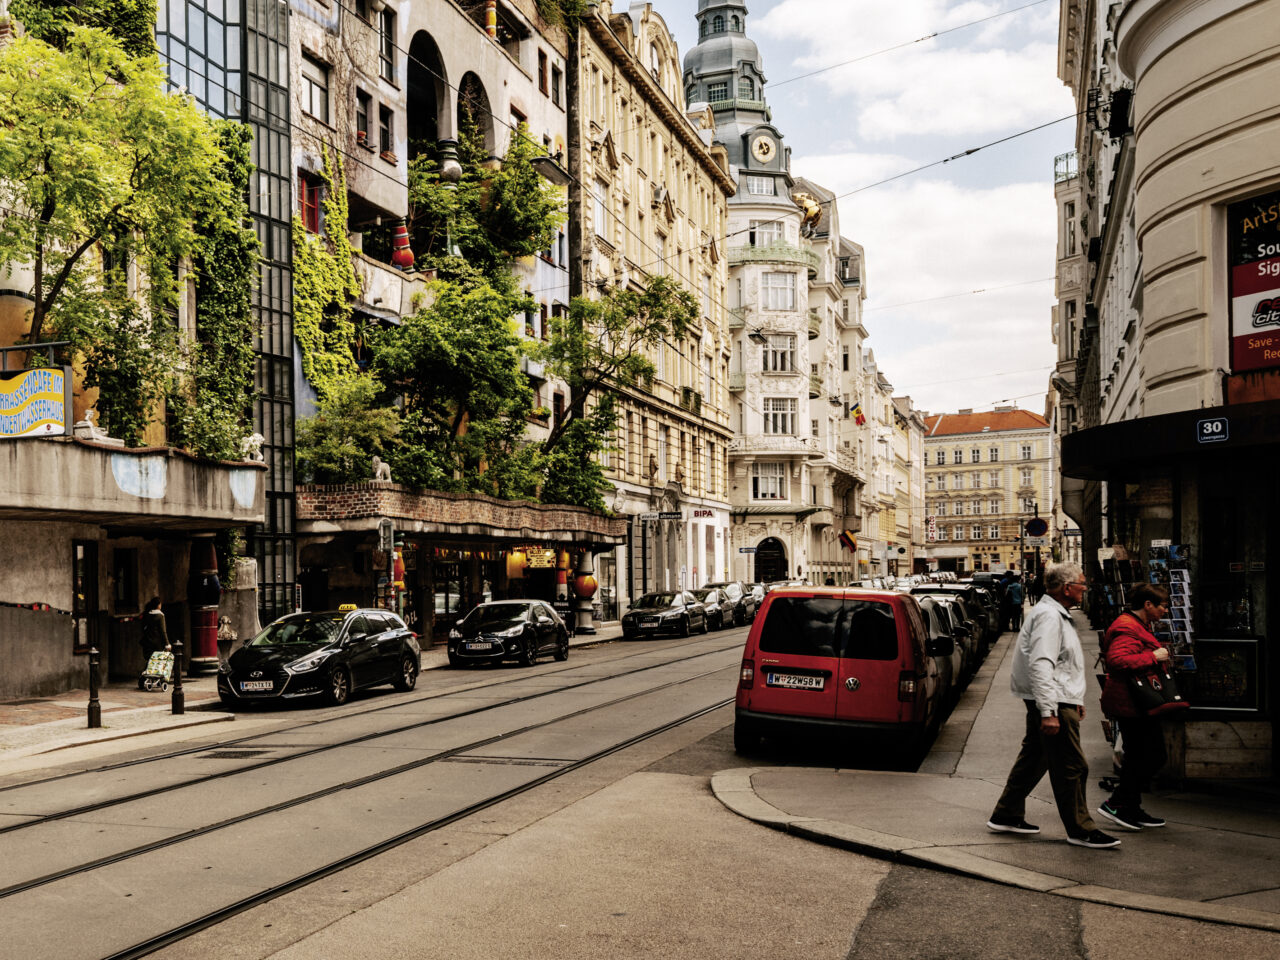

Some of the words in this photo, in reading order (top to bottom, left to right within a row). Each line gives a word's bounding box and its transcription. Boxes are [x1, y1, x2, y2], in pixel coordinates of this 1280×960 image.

[1243, 202, 1280, 235] ArtS
[1256, 309, 1280, 324] cit
[1248, 337, 1273, 349] Save
[53, 375, 63, 394] IM
[1203, 421, 1222, 434] 30
[694, 510, 713, 518] BIPA
[774, 674, 780, 683] W
